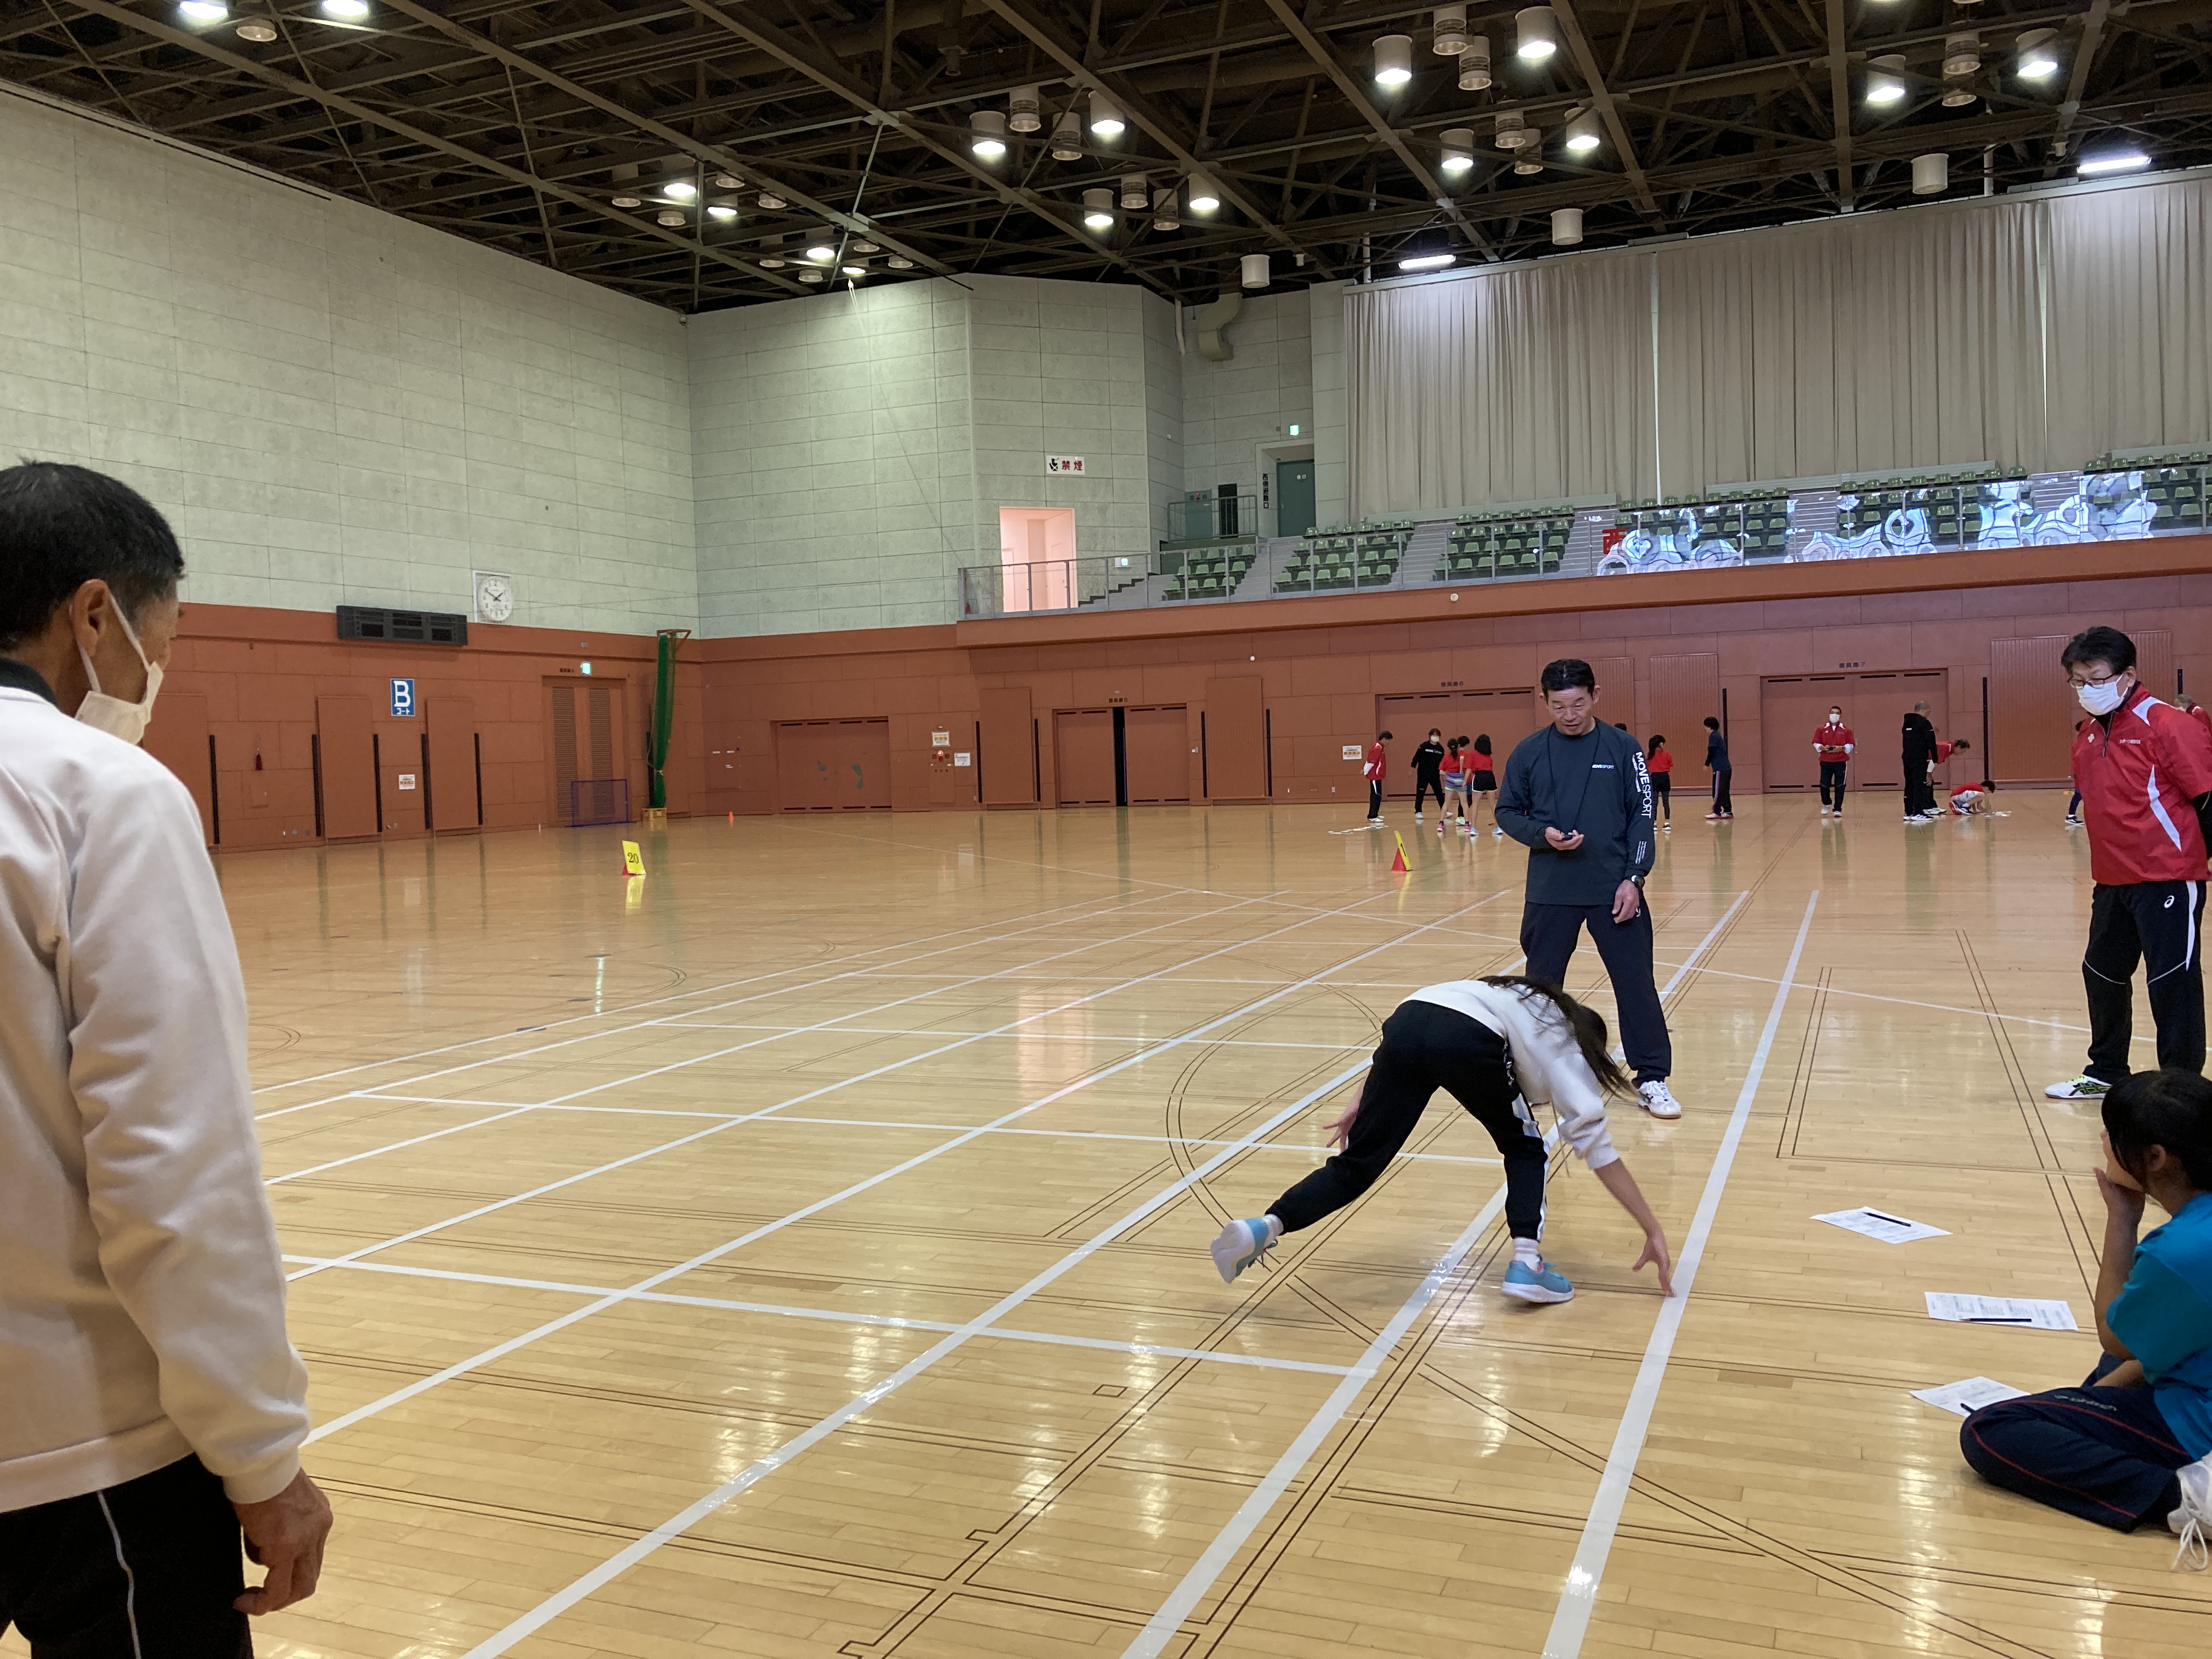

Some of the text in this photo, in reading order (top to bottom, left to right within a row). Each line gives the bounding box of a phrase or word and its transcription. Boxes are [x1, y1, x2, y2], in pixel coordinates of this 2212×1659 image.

[1062, 460, 1082, 471] 禁煙
[393, 680, 411, 707] B
[1636, 752, 1652, 819] MOVESPORT
[627, 852, 639, 864] 20
